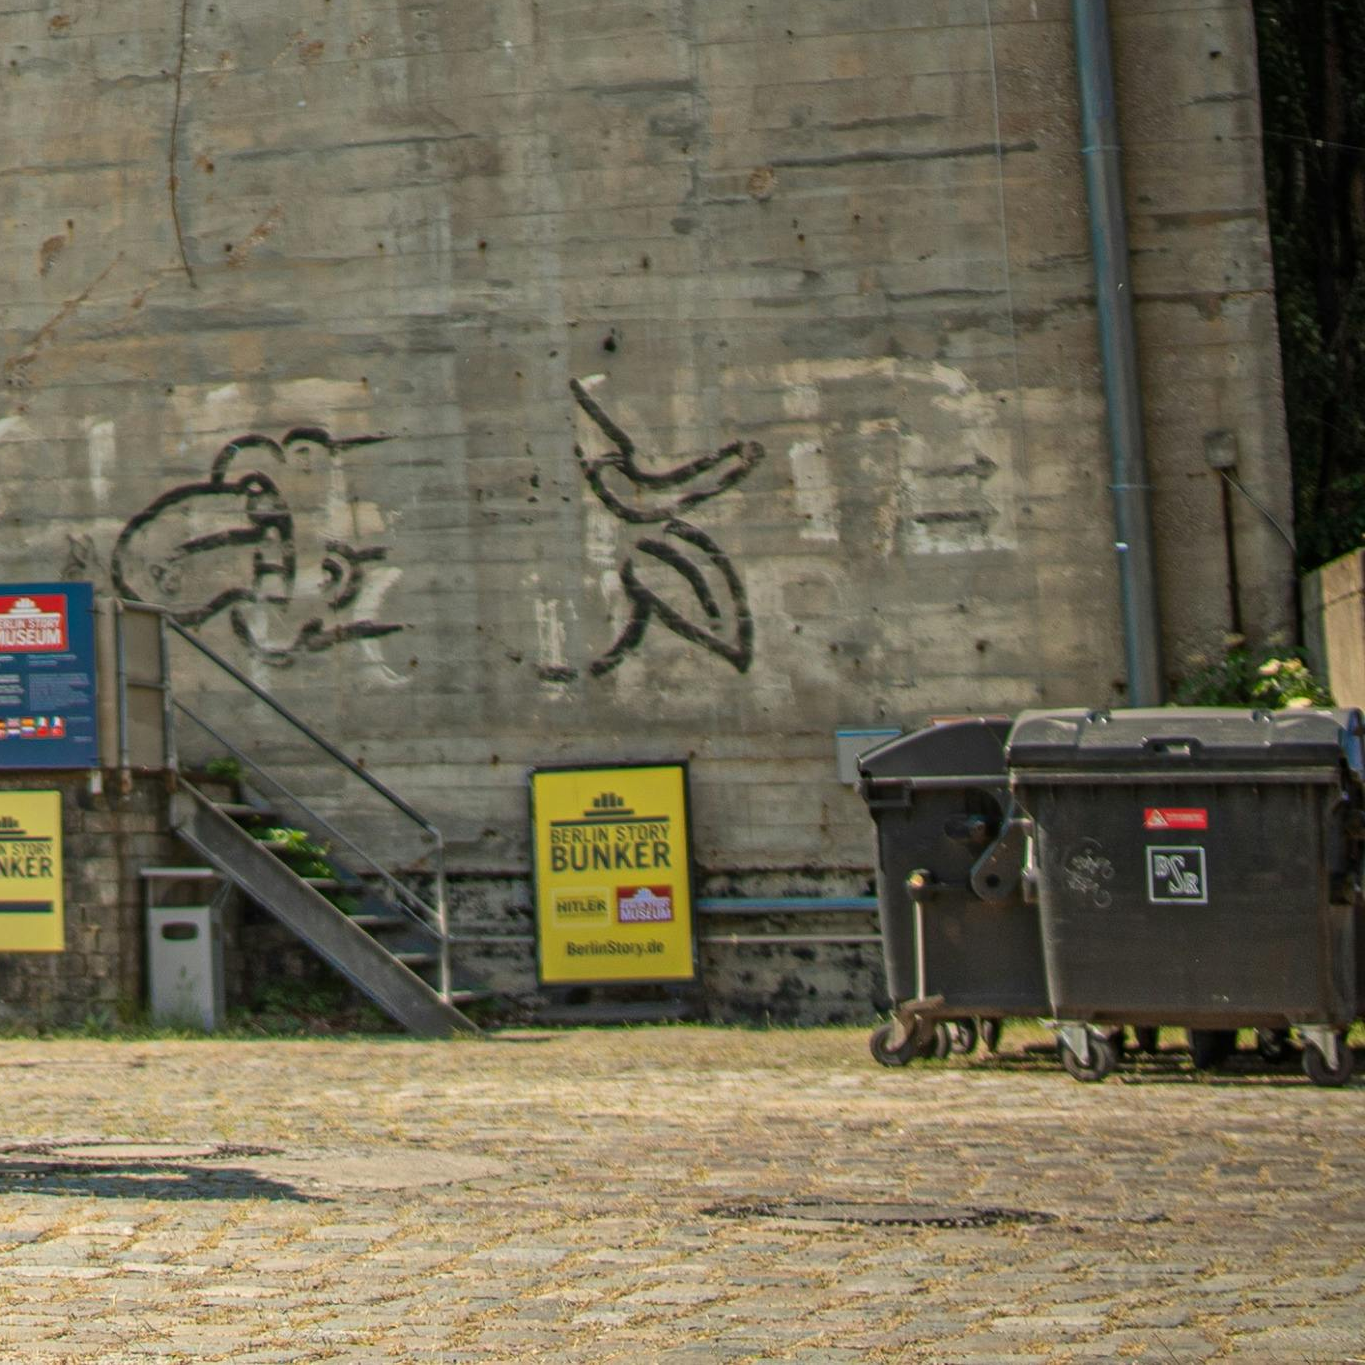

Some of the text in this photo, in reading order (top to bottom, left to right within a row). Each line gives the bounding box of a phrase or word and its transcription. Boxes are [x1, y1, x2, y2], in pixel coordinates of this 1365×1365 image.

[550, 824, 670, 844] BERLIN STORY
[12, 841, 54, 856] STORY
[550, 841, 672, 872] BUNKER
[556, 899, 607, 913] HITLER
[620, 907, 673, 921] MUSEUM
[566, 939, 665, 957] BerlinStory.de
